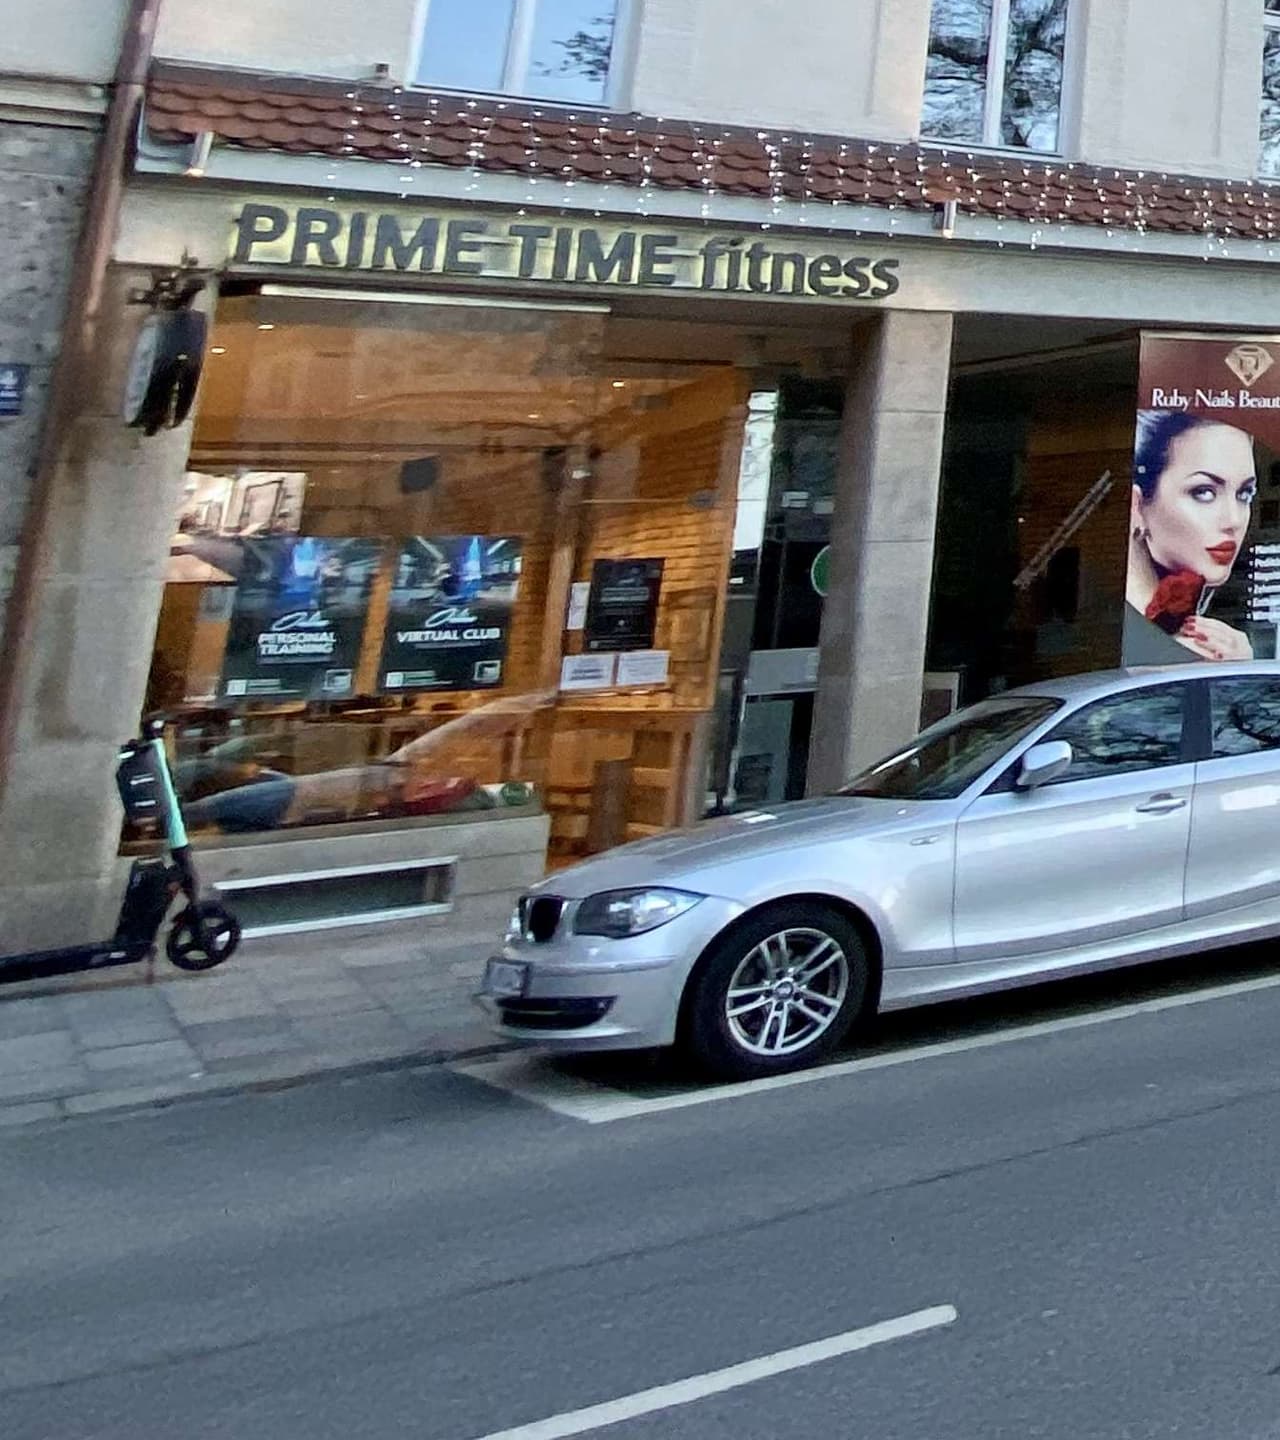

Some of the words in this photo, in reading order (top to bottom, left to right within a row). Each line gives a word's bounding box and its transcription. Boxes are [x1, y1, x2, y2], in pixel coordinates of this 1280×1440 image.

[235, 202, 488, 275] PRIME
[508, 224, 679, 286] TIME
[698, 236, 902, 299] fitness
[1152, 388, 1191, 411] Ruby
[1195, 389, 1235, 408] Nails
[397, 630, 460, 642] VIRTUAL
[462, 627, 500, 640] CLUB
